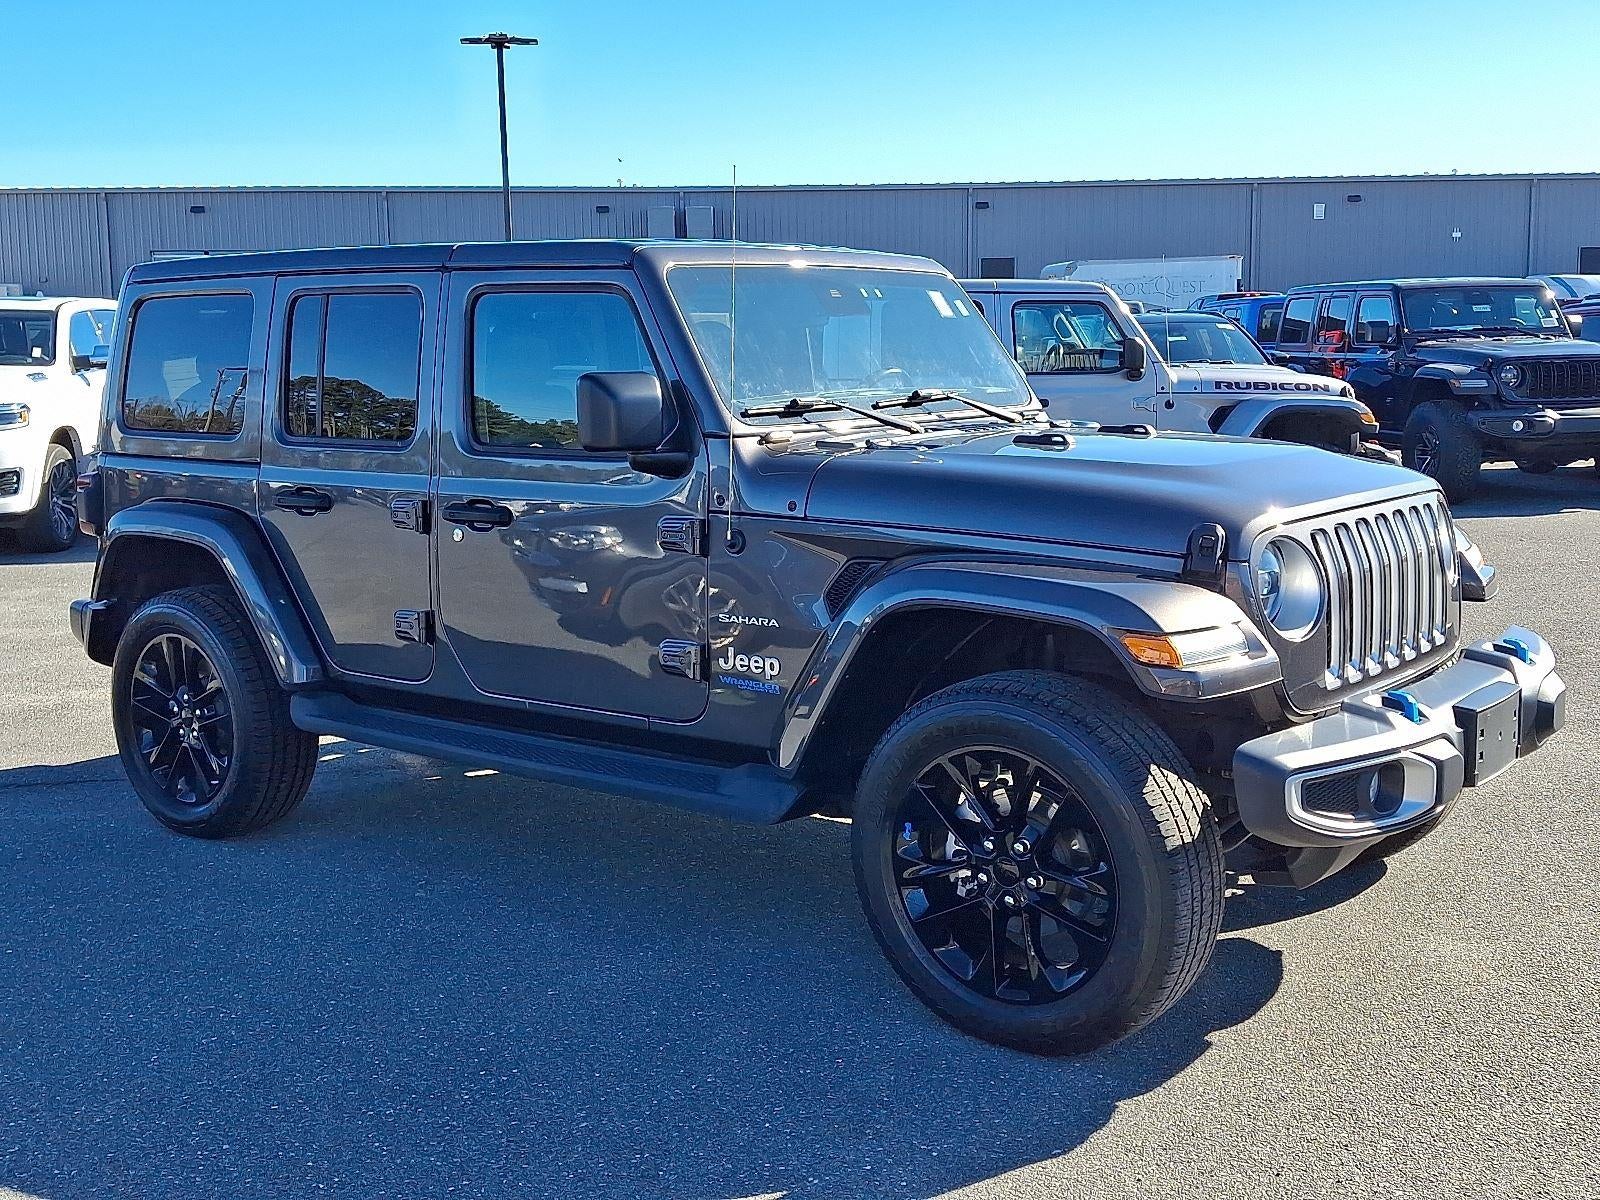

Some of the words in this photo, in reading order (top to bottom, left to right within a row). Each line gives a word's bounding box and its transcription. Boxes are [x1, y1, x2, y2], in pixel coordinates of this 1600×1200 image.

[1214, 380, 1331, 392] RUBICON
[718, 613, 780, 628] SAHARA
[718, 646, 781, 680] Jeep
[719, 674, 780, 690] WRANGLER
